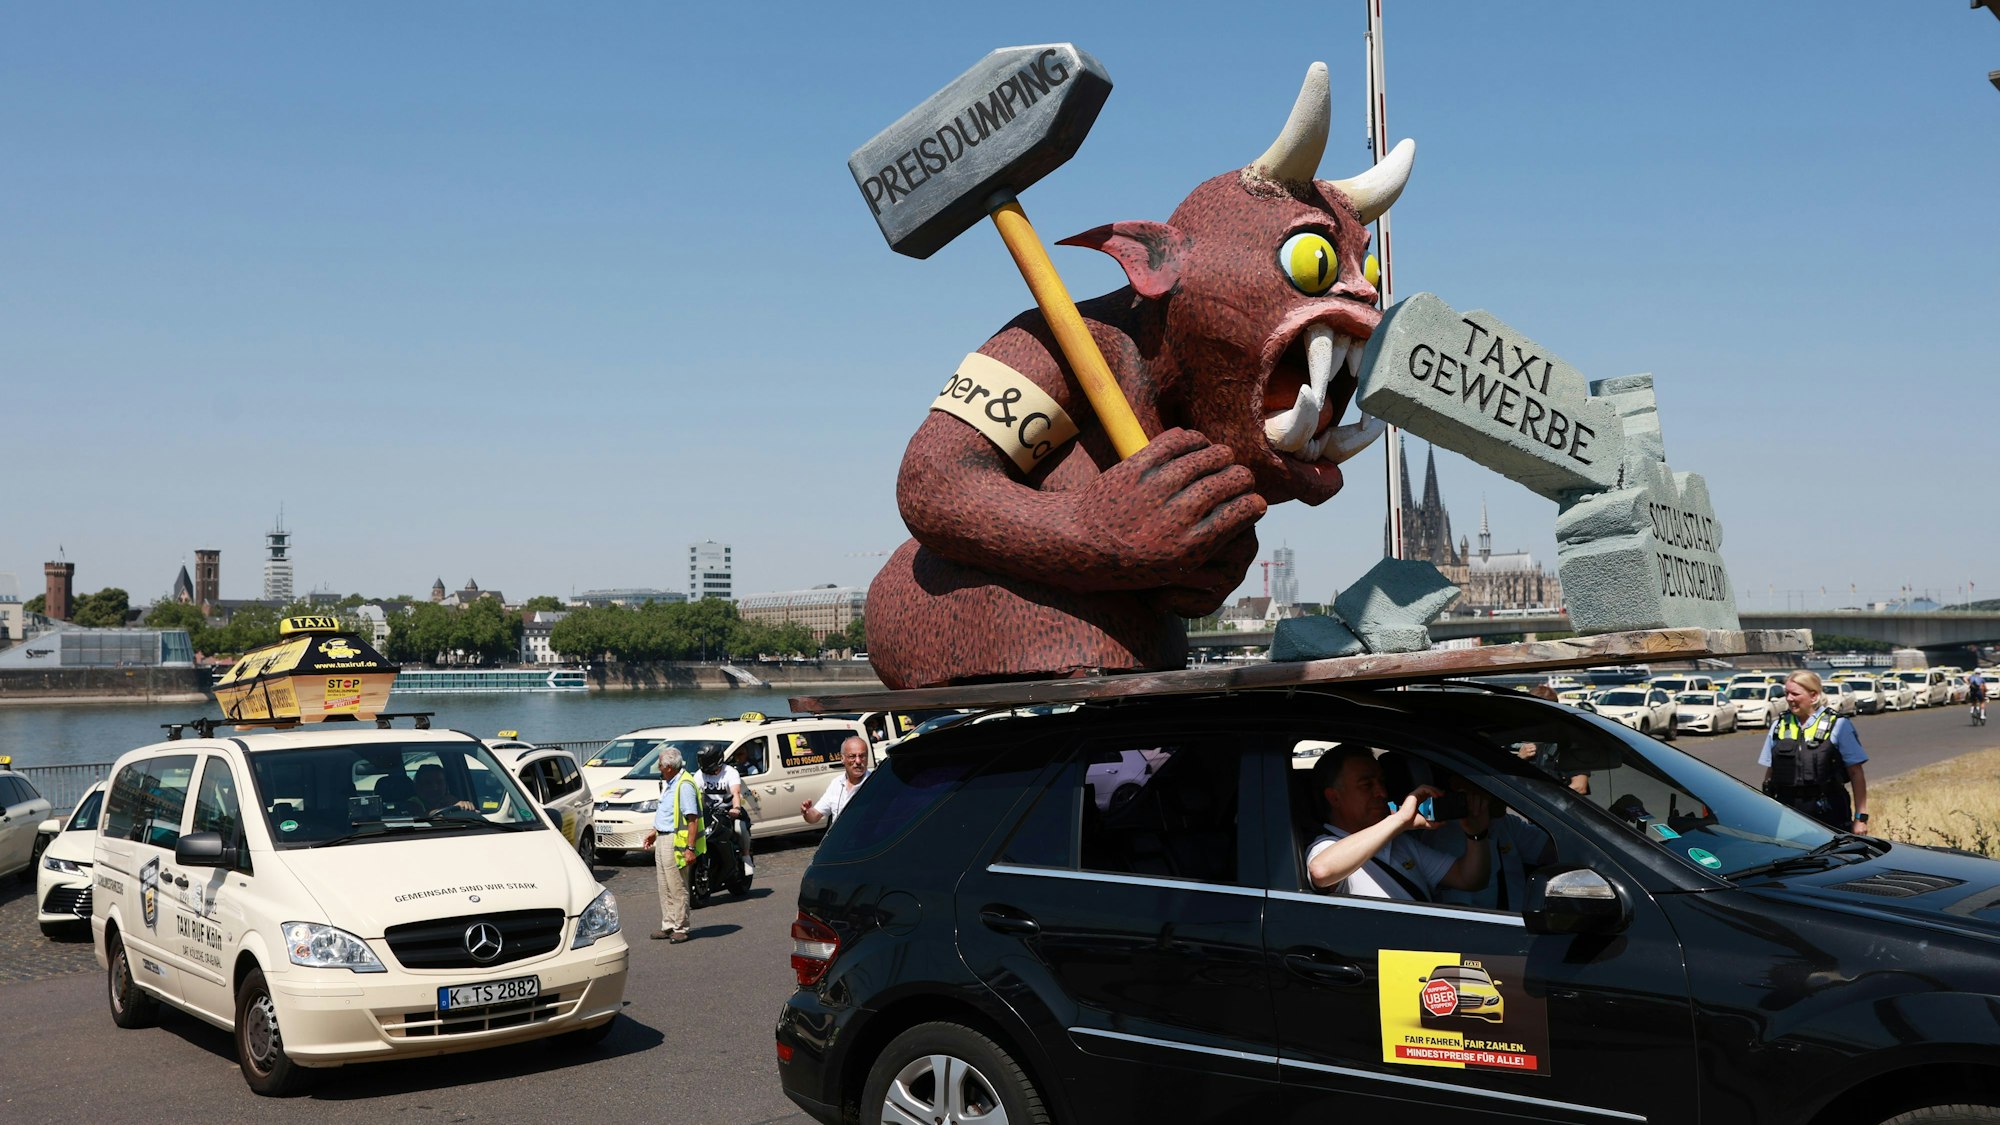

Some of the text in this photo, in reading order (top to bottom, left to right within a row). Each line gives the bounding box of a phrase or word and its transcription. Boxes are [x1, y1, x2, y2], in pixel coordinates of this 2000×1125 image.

[862, 48, 1070, 215] PREISDUMPING
[1460, 317, 1553, 396] TAXI
[1409, 343, 1596, 465] GEWERBE
[1649, 501, 1716, 555] SOZIALSTAAT
[1656, 551, 1726, 601] DEUTSCHLAND
[293, 617, 332, 628] TAXI
[314, 661, 377, 670] www.taxiruf.de
[328, 679, 360, 688] STOP
[786, 757, 801, 766] 0170
[394, 887, 458, 903] GEMEINSAM
[459, 884, 483, 893] SIND
[177, 915, 222, 951] TAXI RUF Köln
[450, 989, 461, 1006] K
[472, 985, 493, 1003] TS
[498, 978, 537, 1000] 2882
[1425, 991, 1455, 1004] UBER
[1404, 1035, 1526, 1053] FAIR FAHREN, FAIR ZAHLEN.
[1406, 1048, 1524, 1066] MINDESTPREISE FÜR ALLE!
